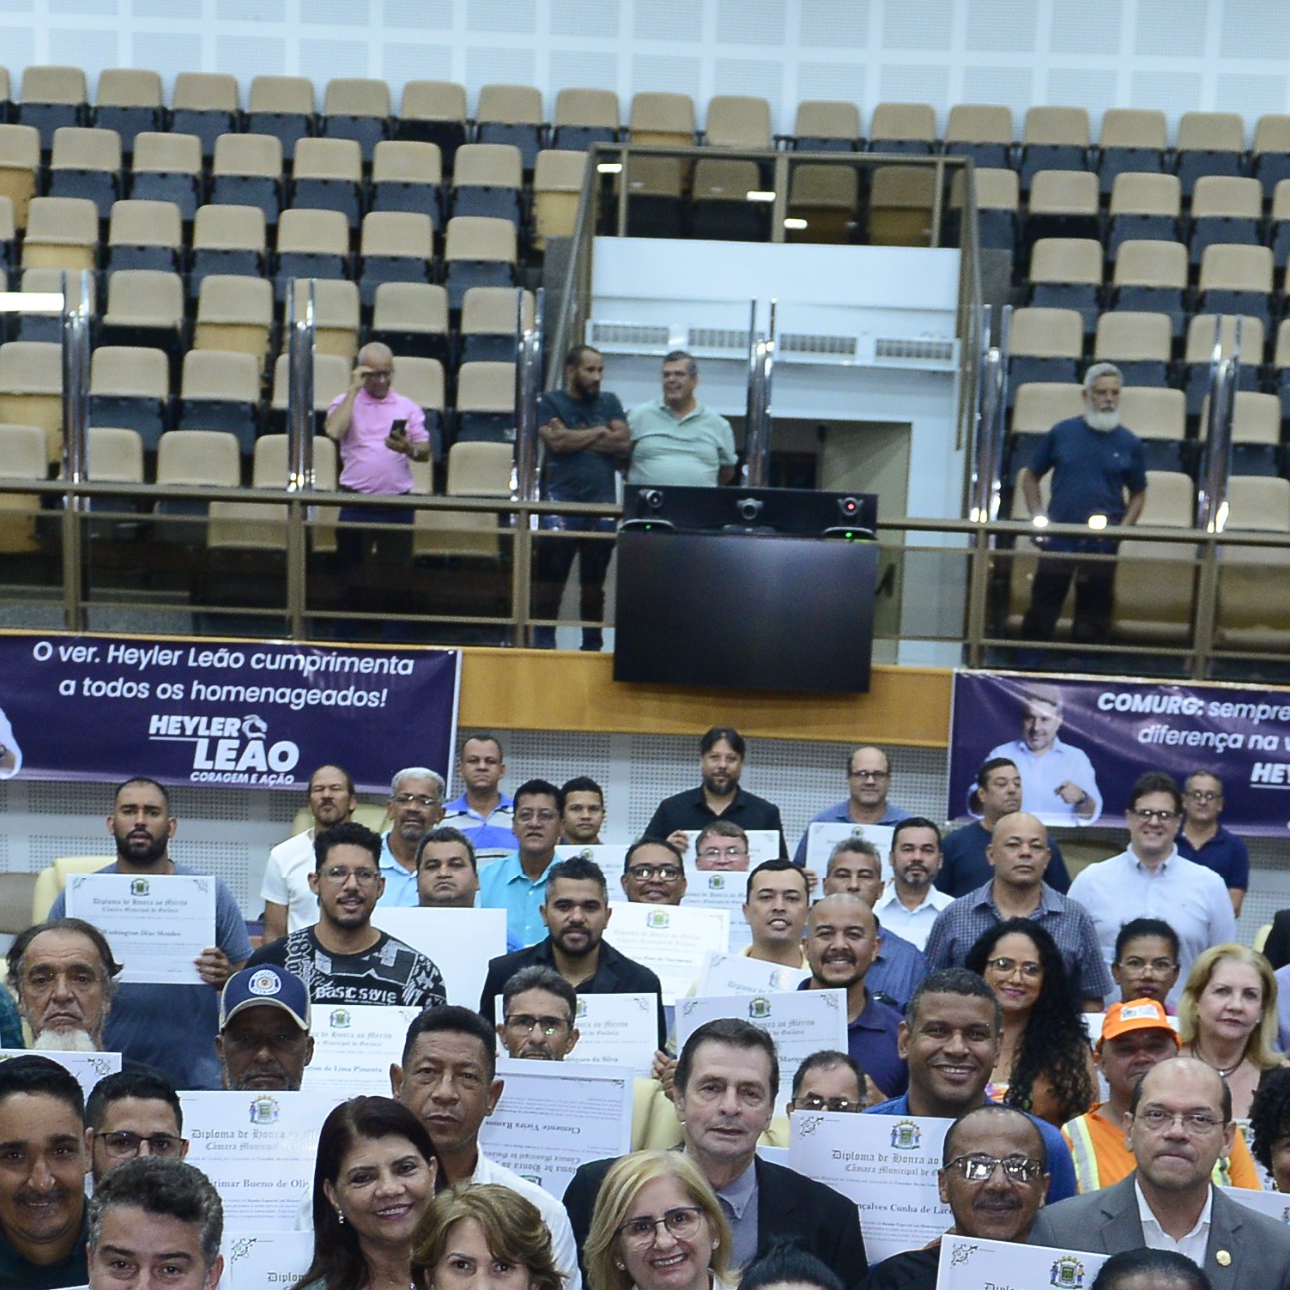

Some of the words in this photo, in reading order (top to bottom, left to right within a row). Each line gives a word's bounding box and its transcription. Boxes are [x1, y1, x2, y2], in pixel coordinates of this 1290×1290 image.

[33, 641, 51, 663] O
[58, 645, 100, 664] ver.
[107, 643, 182, 670] Heyler
[188, 646, 243, 670] Leão
[251, 653, 414, 677] cumprimenta
[59, 681, 75, 697] a
[81, 677, 149, 699] todos
[156, 684, 184, 701] os
[191, 683, 388, 711] homenageados!
[1098, 693, 1204, 716] COMURG:
[149, 715, 240, 738] HEYLER
[1138, 725, 1242, 754] diferença
[1249, 737, 1277, 751] na
[251, 773, 258, 784] E
